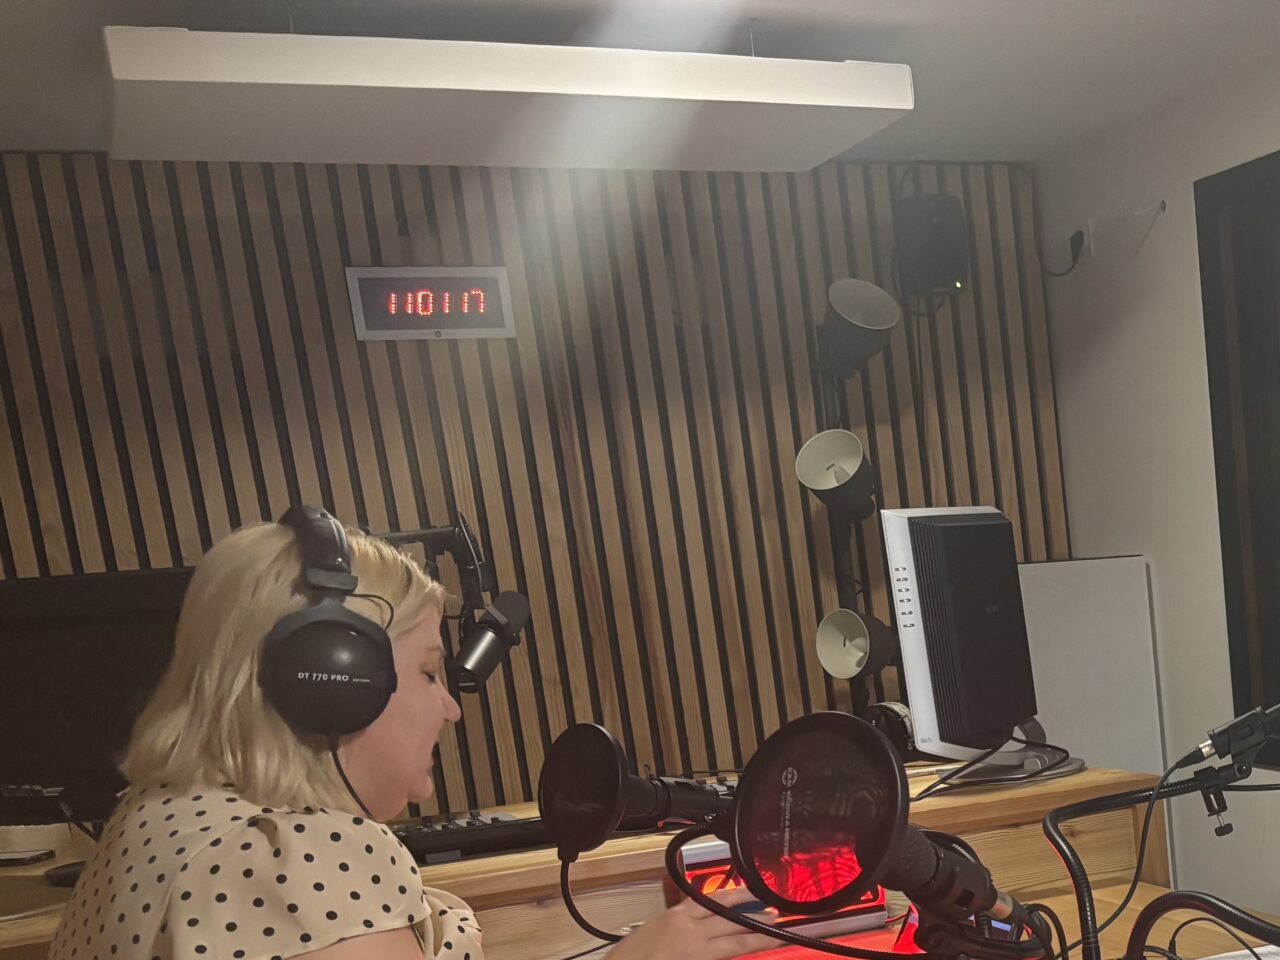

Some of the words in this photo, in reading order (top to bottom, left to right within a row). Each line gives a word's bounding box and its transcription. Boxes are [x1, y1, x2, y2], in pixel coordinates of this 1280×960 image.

[298, 672, 310, 680] DT
[312, 673, 328, 682] 770
[330, 674, 350, 682] PRO
